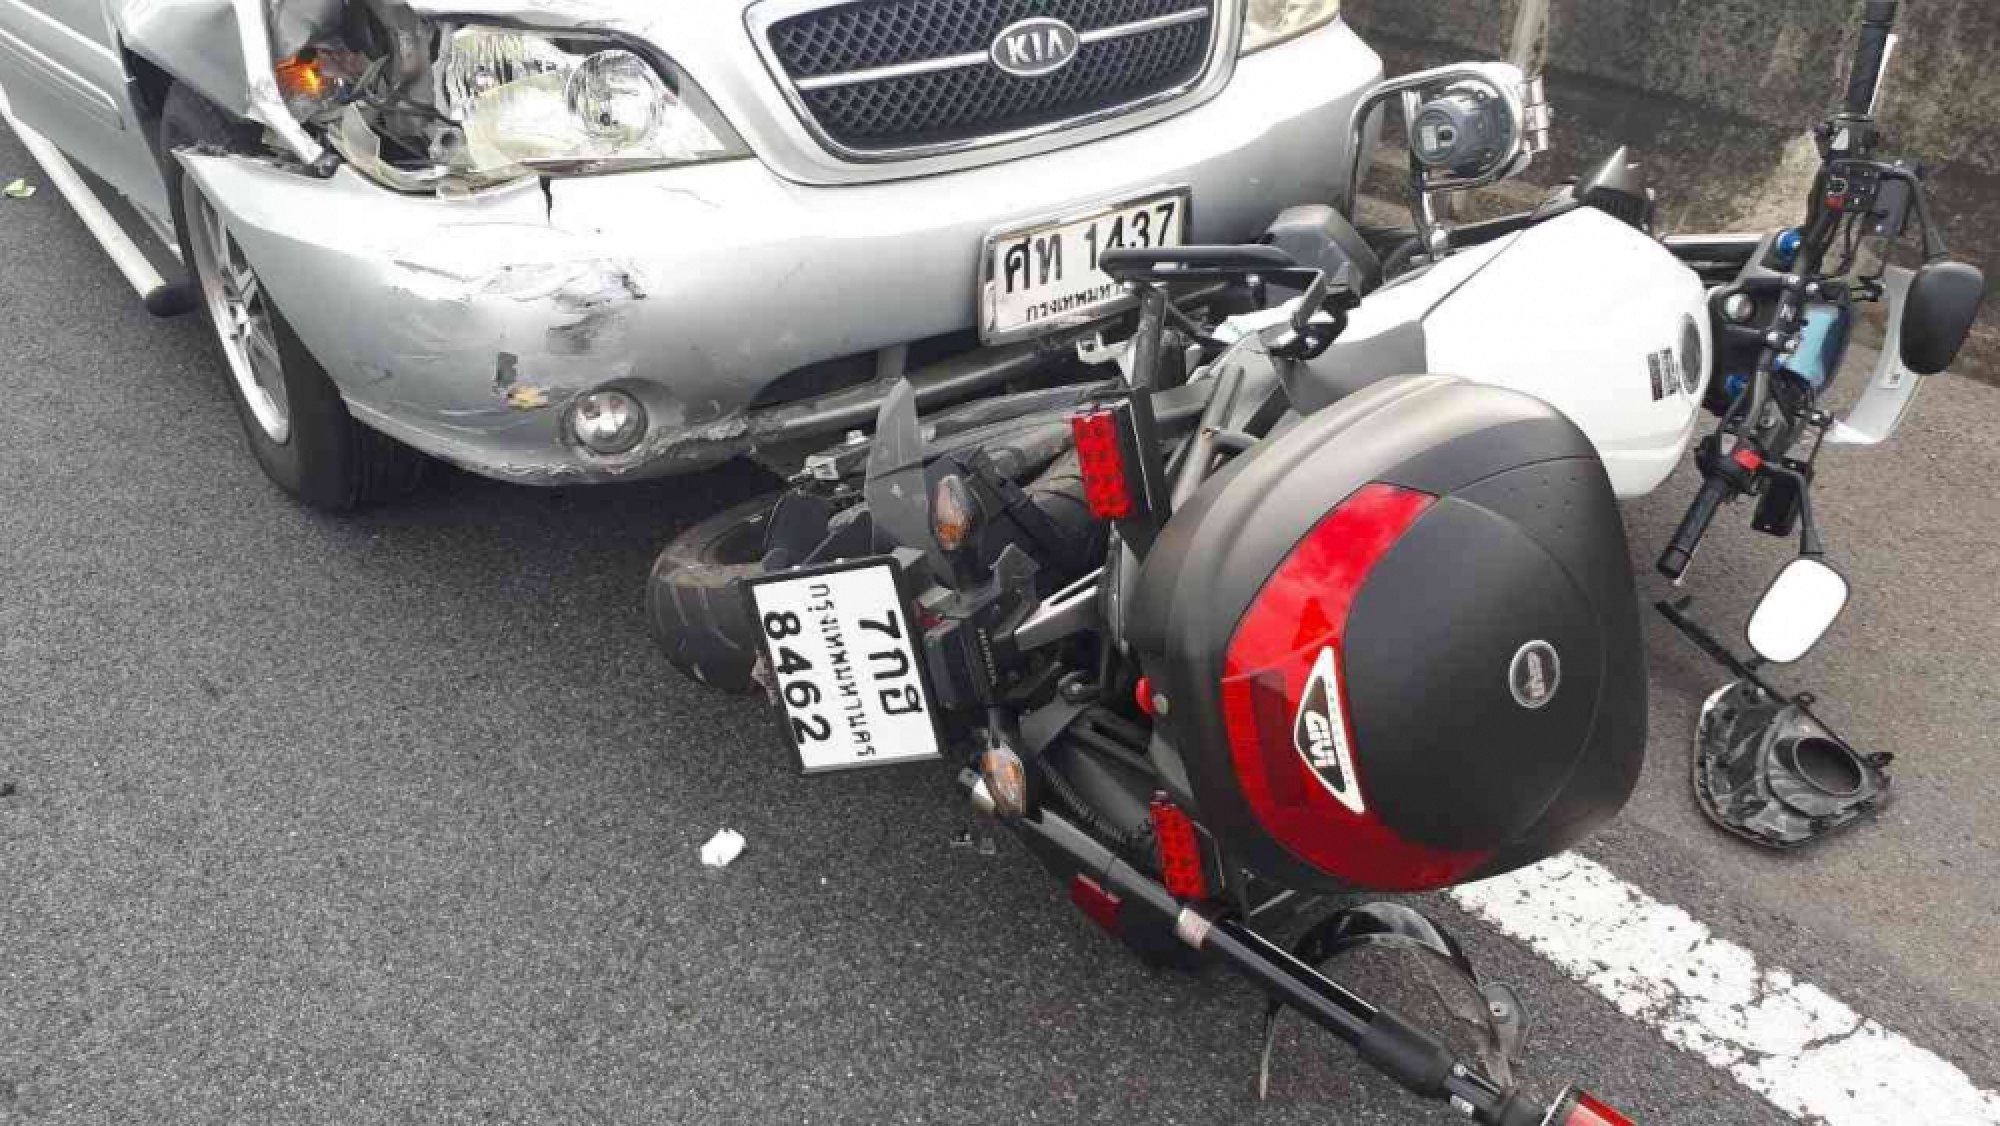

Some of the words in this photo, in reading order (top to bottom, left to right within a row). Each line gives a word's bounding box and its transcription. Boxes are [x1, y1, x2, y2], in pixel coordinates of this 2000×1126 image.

[1006, 29, 1064, 64] KIA
[1004, 234, 1062, 293] ศท
[1085, 202, 1175, 271] 1437
[763, 611, 832, 745] 8462
[808, 583, 876, 757] กรุงเทพมหานคร
[1304, 709, 1338, 768] GIVI
